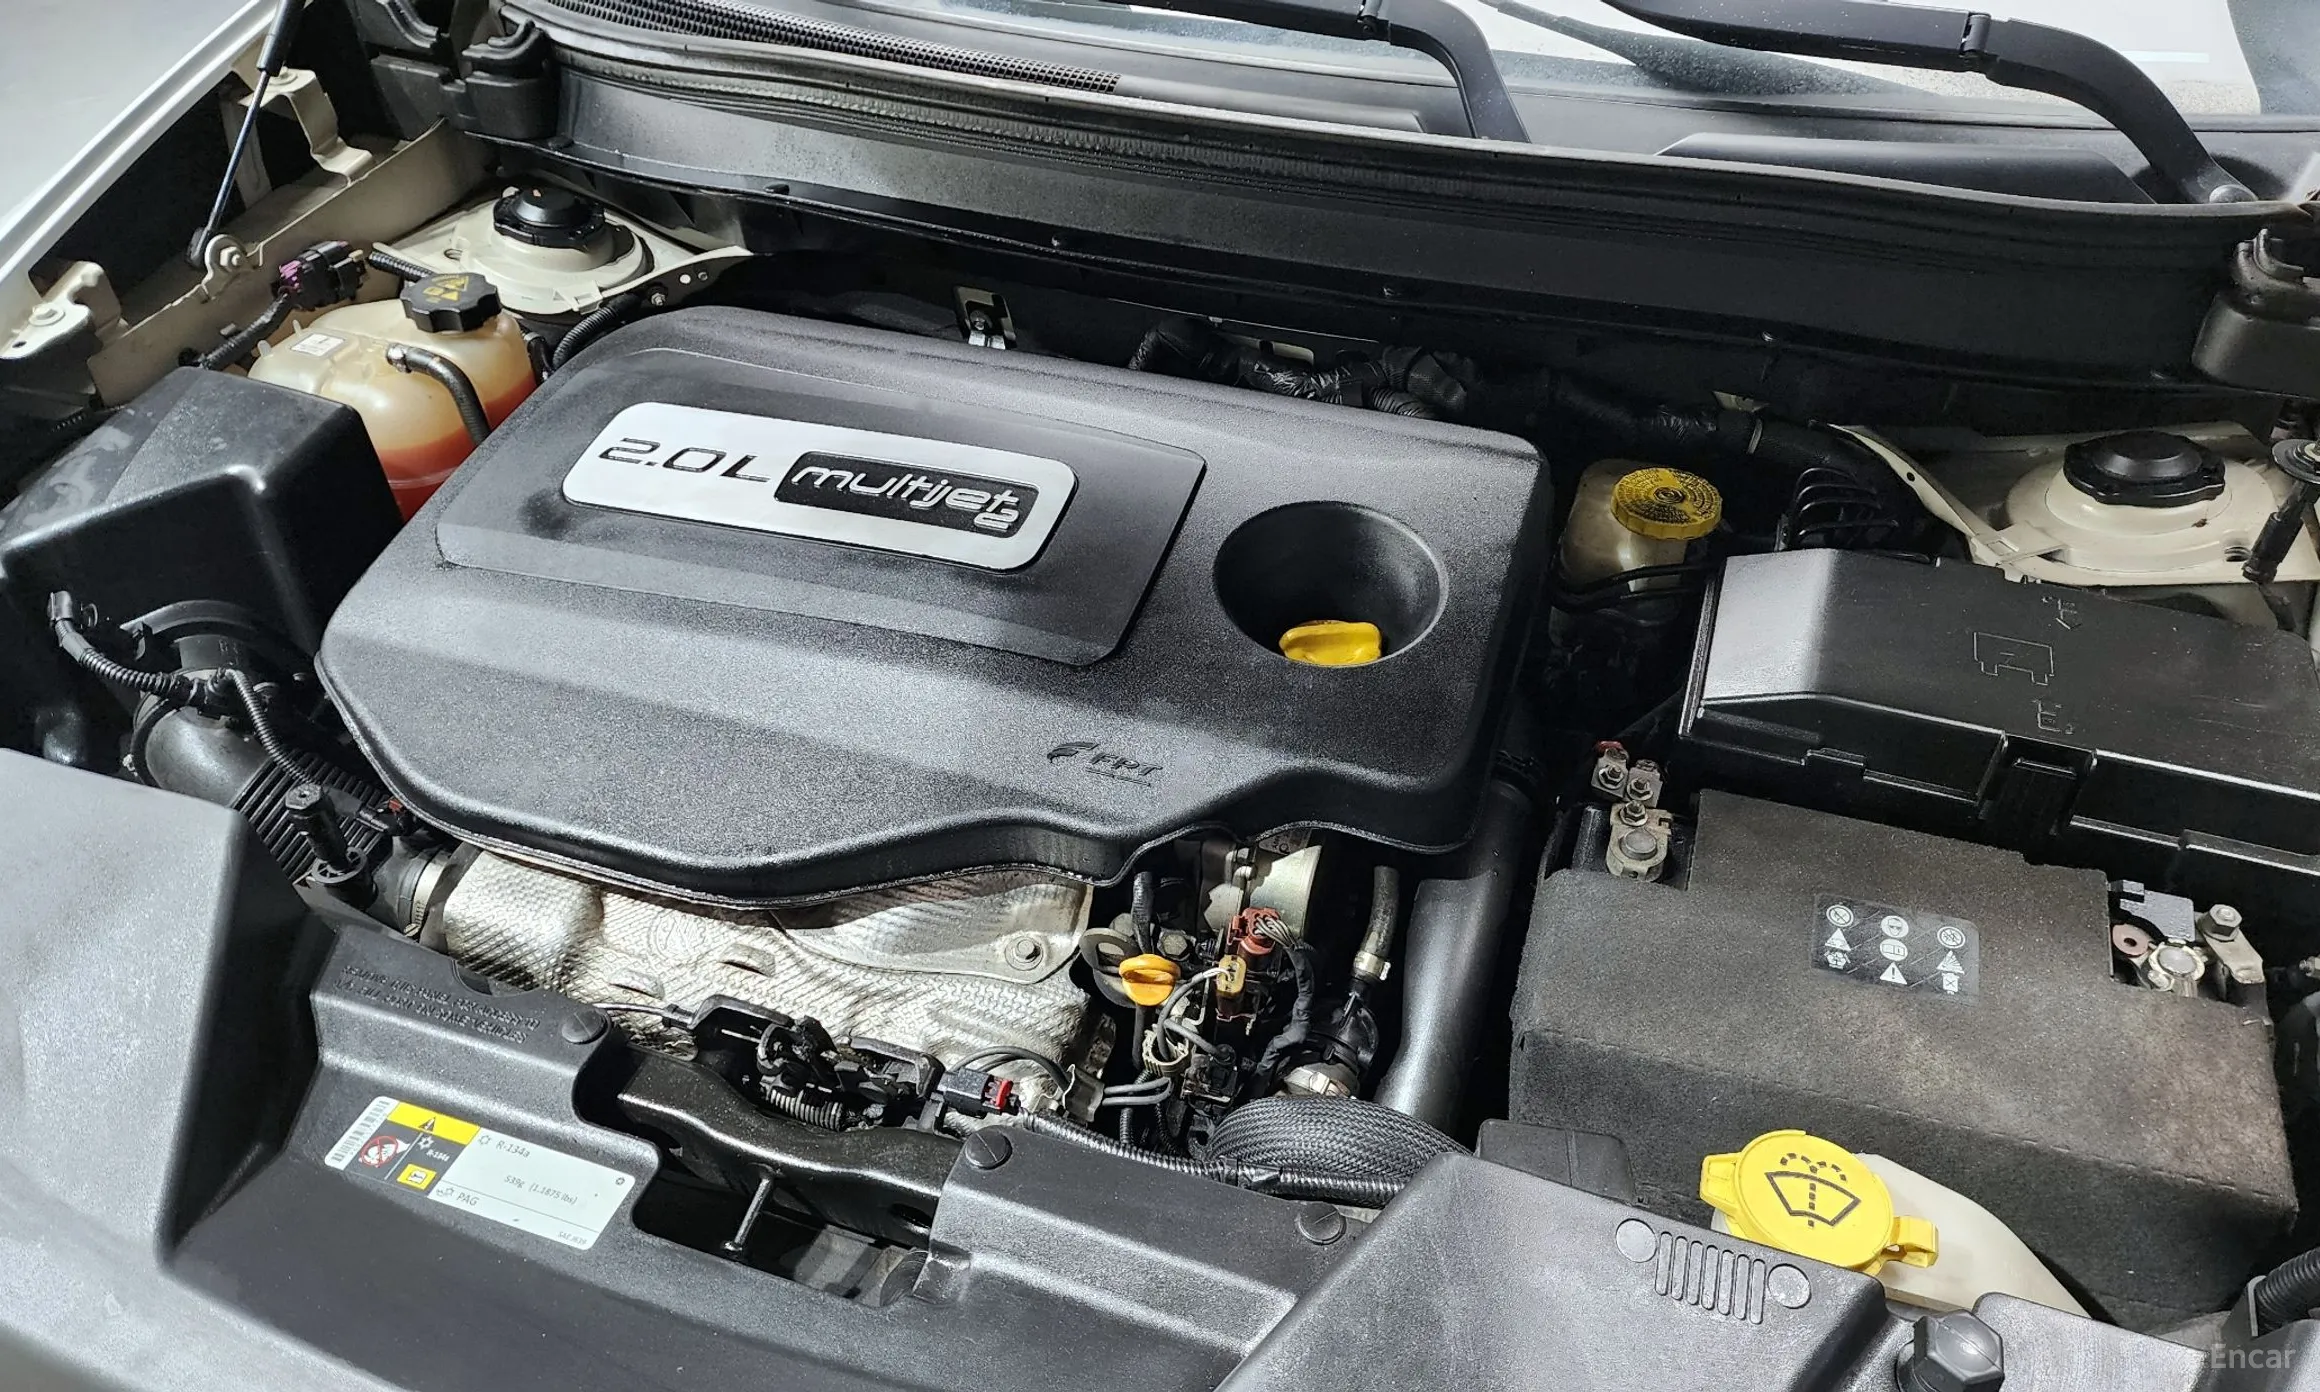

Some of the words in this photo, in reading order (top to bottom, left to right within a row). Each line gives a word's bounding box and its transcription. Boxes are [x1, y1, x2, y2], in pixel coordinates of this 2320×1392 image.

[790, 465, 1019, 510] multijet
[973, 507, 1019, 531] 2
[471, 1019, 528, 1044] VEHICLES
[495, 1140, 531, 1160] R-134a
[456, 1191, 480, 1207] PAG
